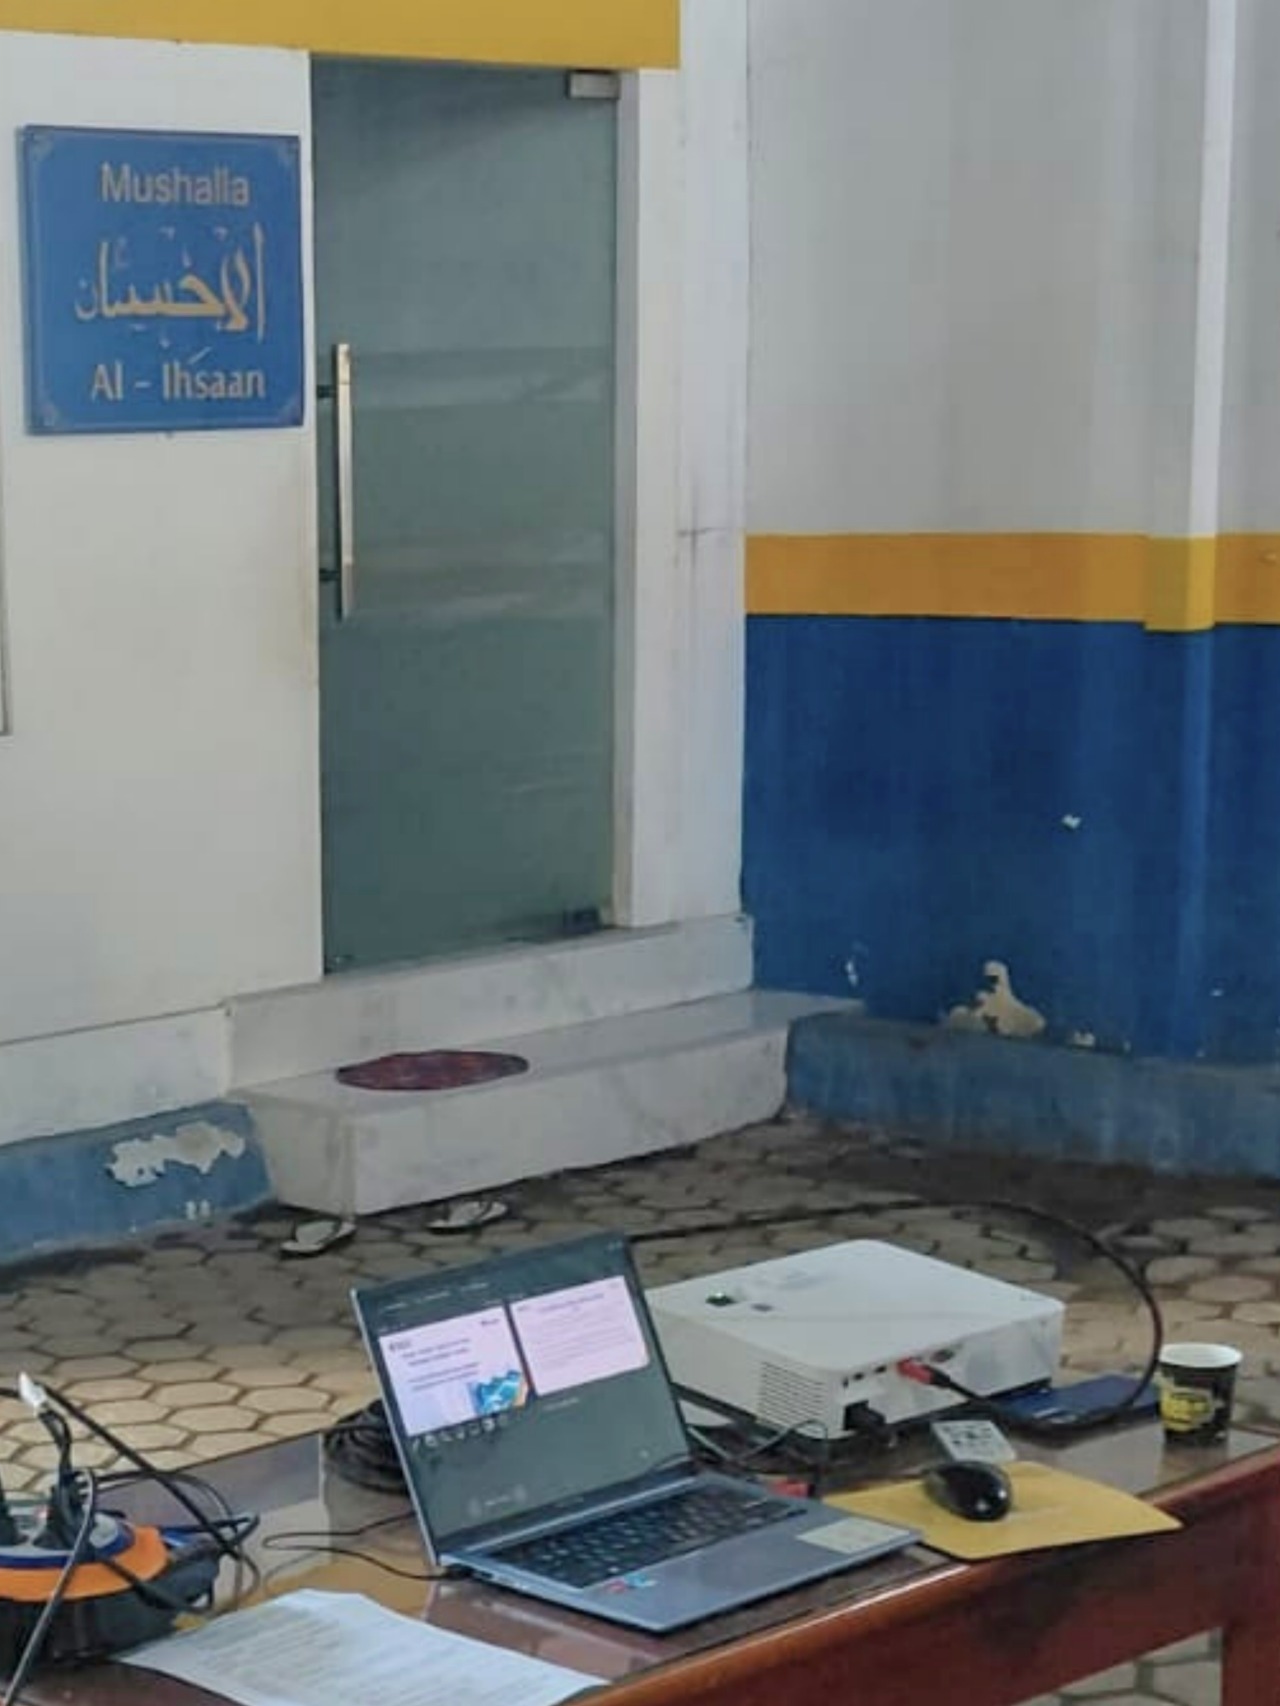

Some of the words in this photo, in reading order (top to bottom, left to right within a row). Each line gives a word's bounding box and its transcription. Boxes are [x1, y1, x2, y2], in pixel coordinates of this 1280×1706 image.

[100, 161, 250, 206] Mushalla
[91, 360, 123, 400] Al
[162, 360, 266, 400] Ihsaan
